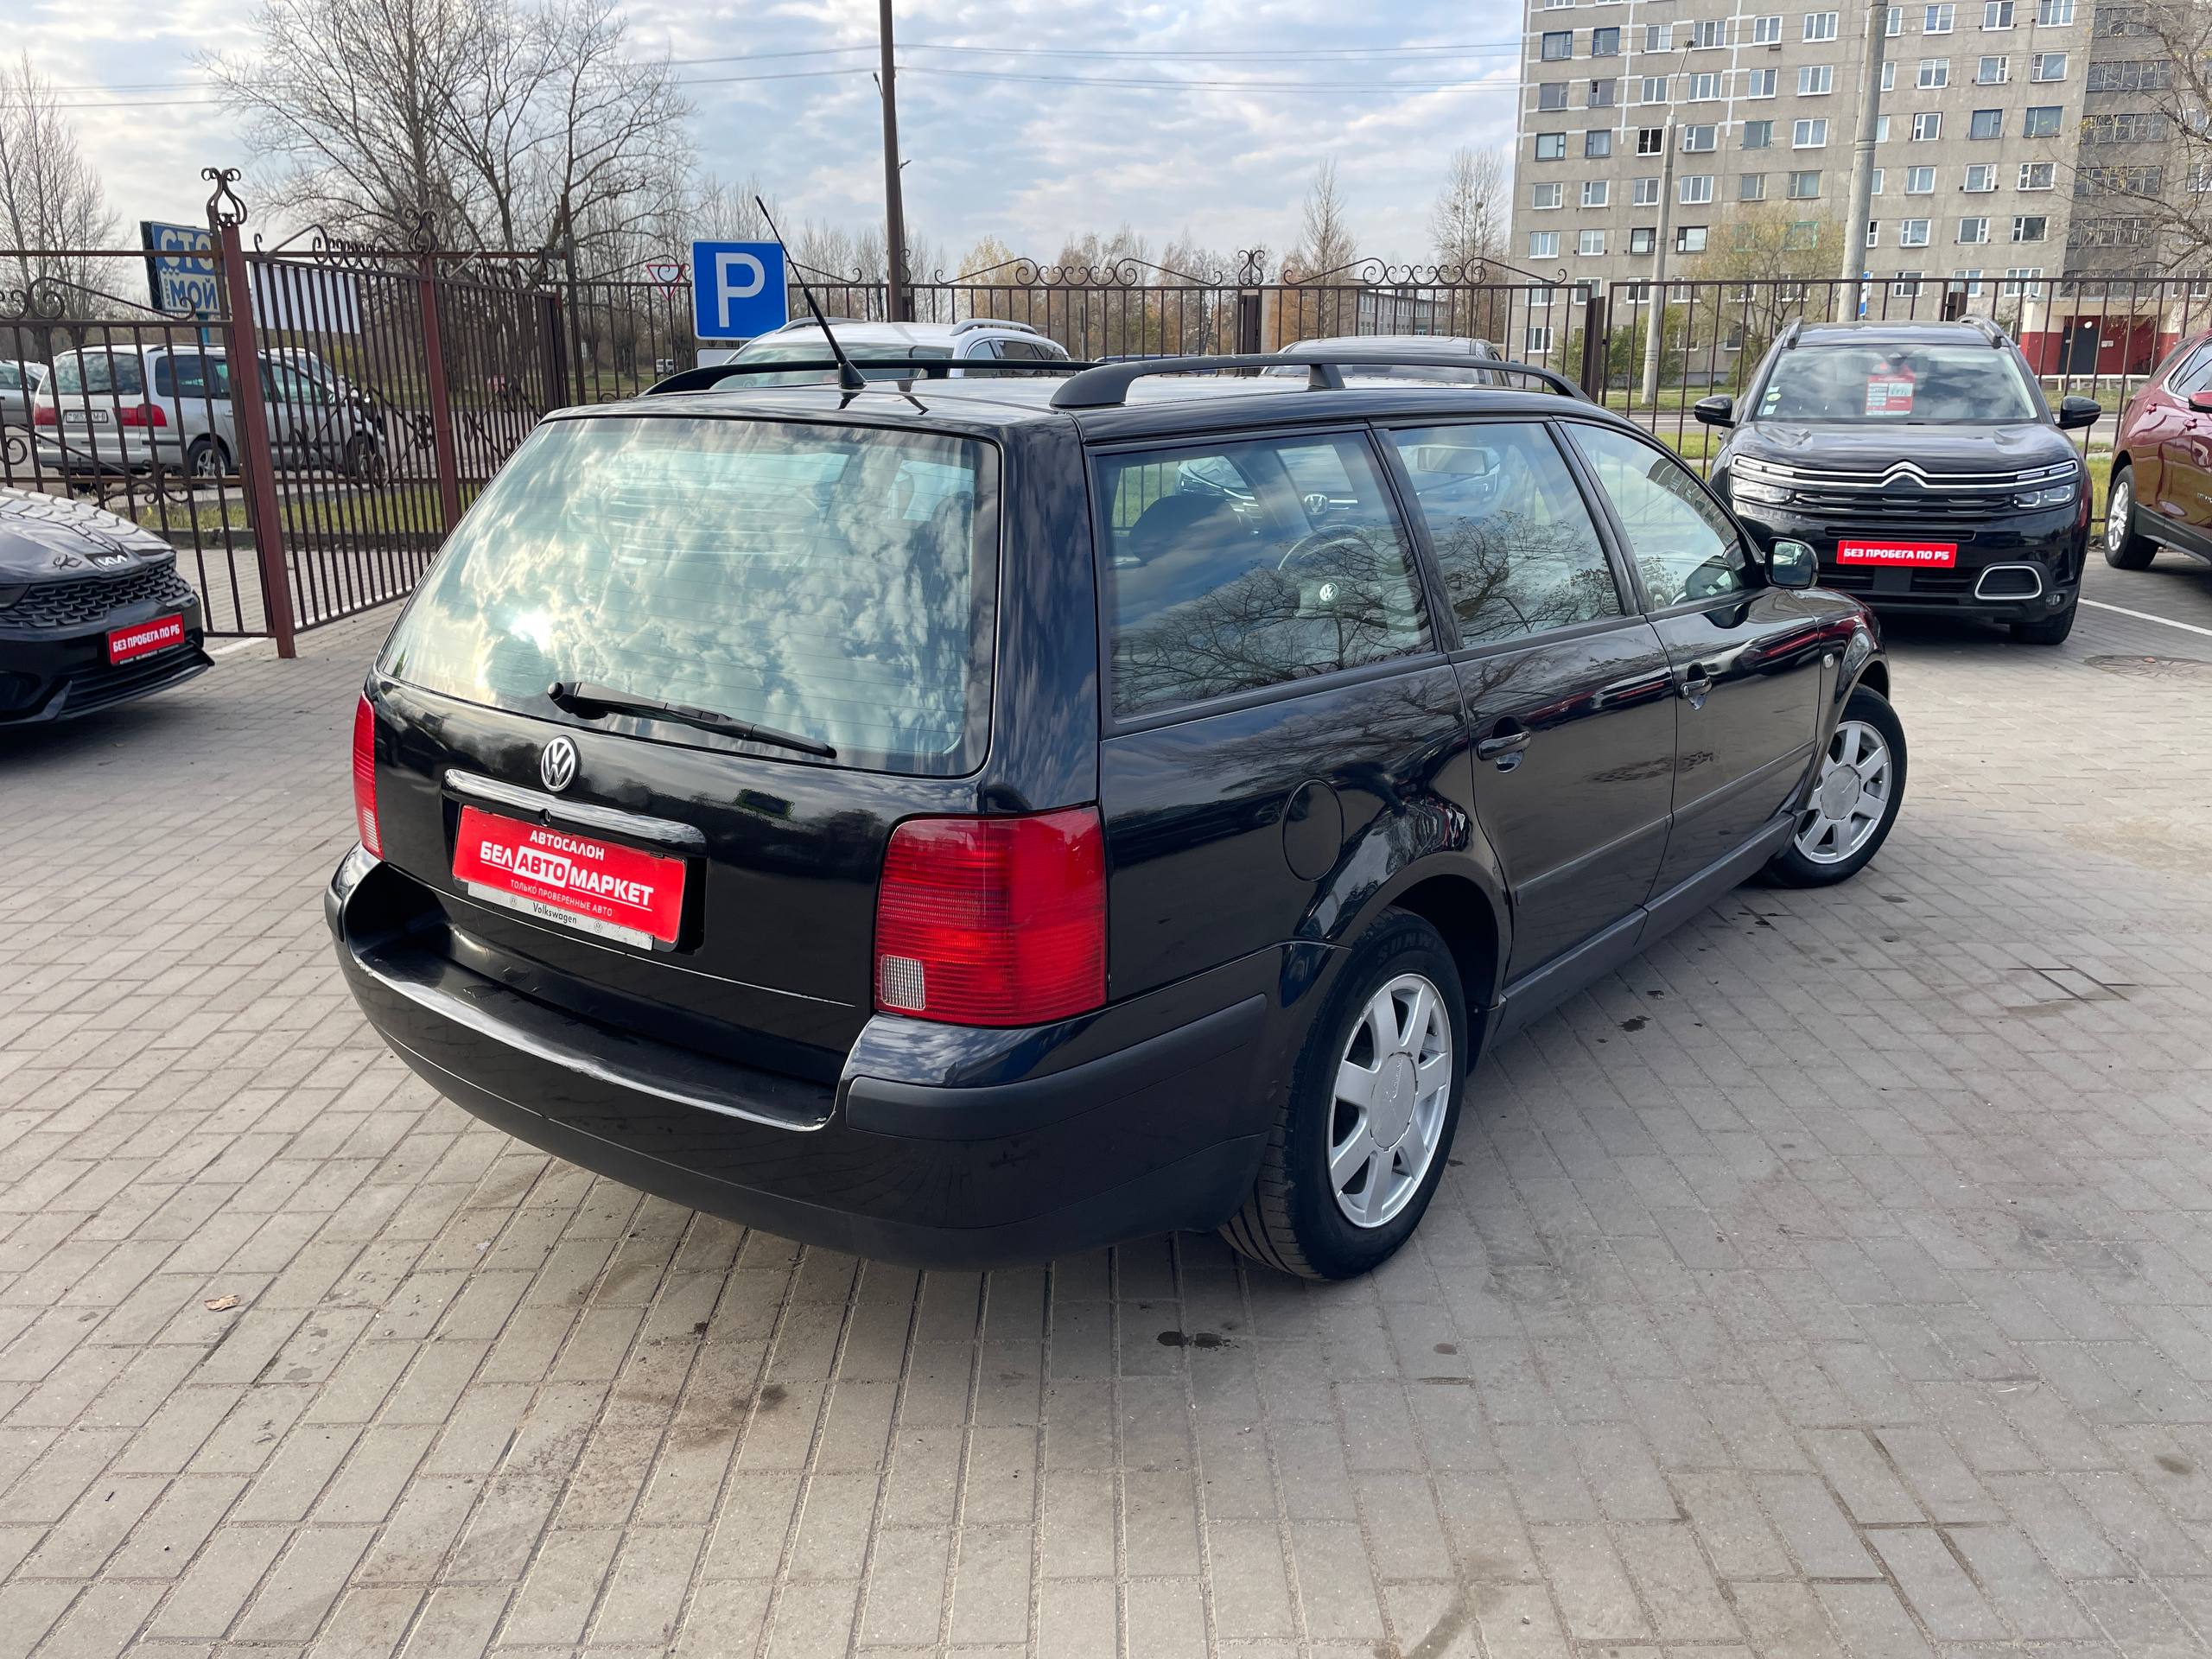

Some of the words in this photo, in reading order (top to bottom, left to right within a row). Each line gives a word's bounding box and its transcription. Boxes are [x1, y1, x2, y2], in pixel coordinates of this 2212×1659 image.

[160, 229, 213, 270] СТО
[169, 277, 228, 310] МОЙ
[715, 252, 765, 327] P
[1844, 548, 1864, 557] БЕЗ
[1866, 549, 1914, 559] ПРОБЕГА
[1916, 550, 1932, 560] ПО
[1934, 551, 1949, 561] РБ
[112, 639, 127, 653] БЕЗ
[127, 630, 159, 648] ПРОБЕГА
[160, 627, 170, 639] ПО
[171, 624, 181, 636] РБ
[530, 830, 605, 861] АВТОСАЛОН
[511, 879, 537, 894] ТОЛЬКО
[537, 887, 592, 909] ПРОВЕРЕННЫЕ
[592, 904, 613, 917] АВТО
[532, 902, 577, 924] Volkswagen
